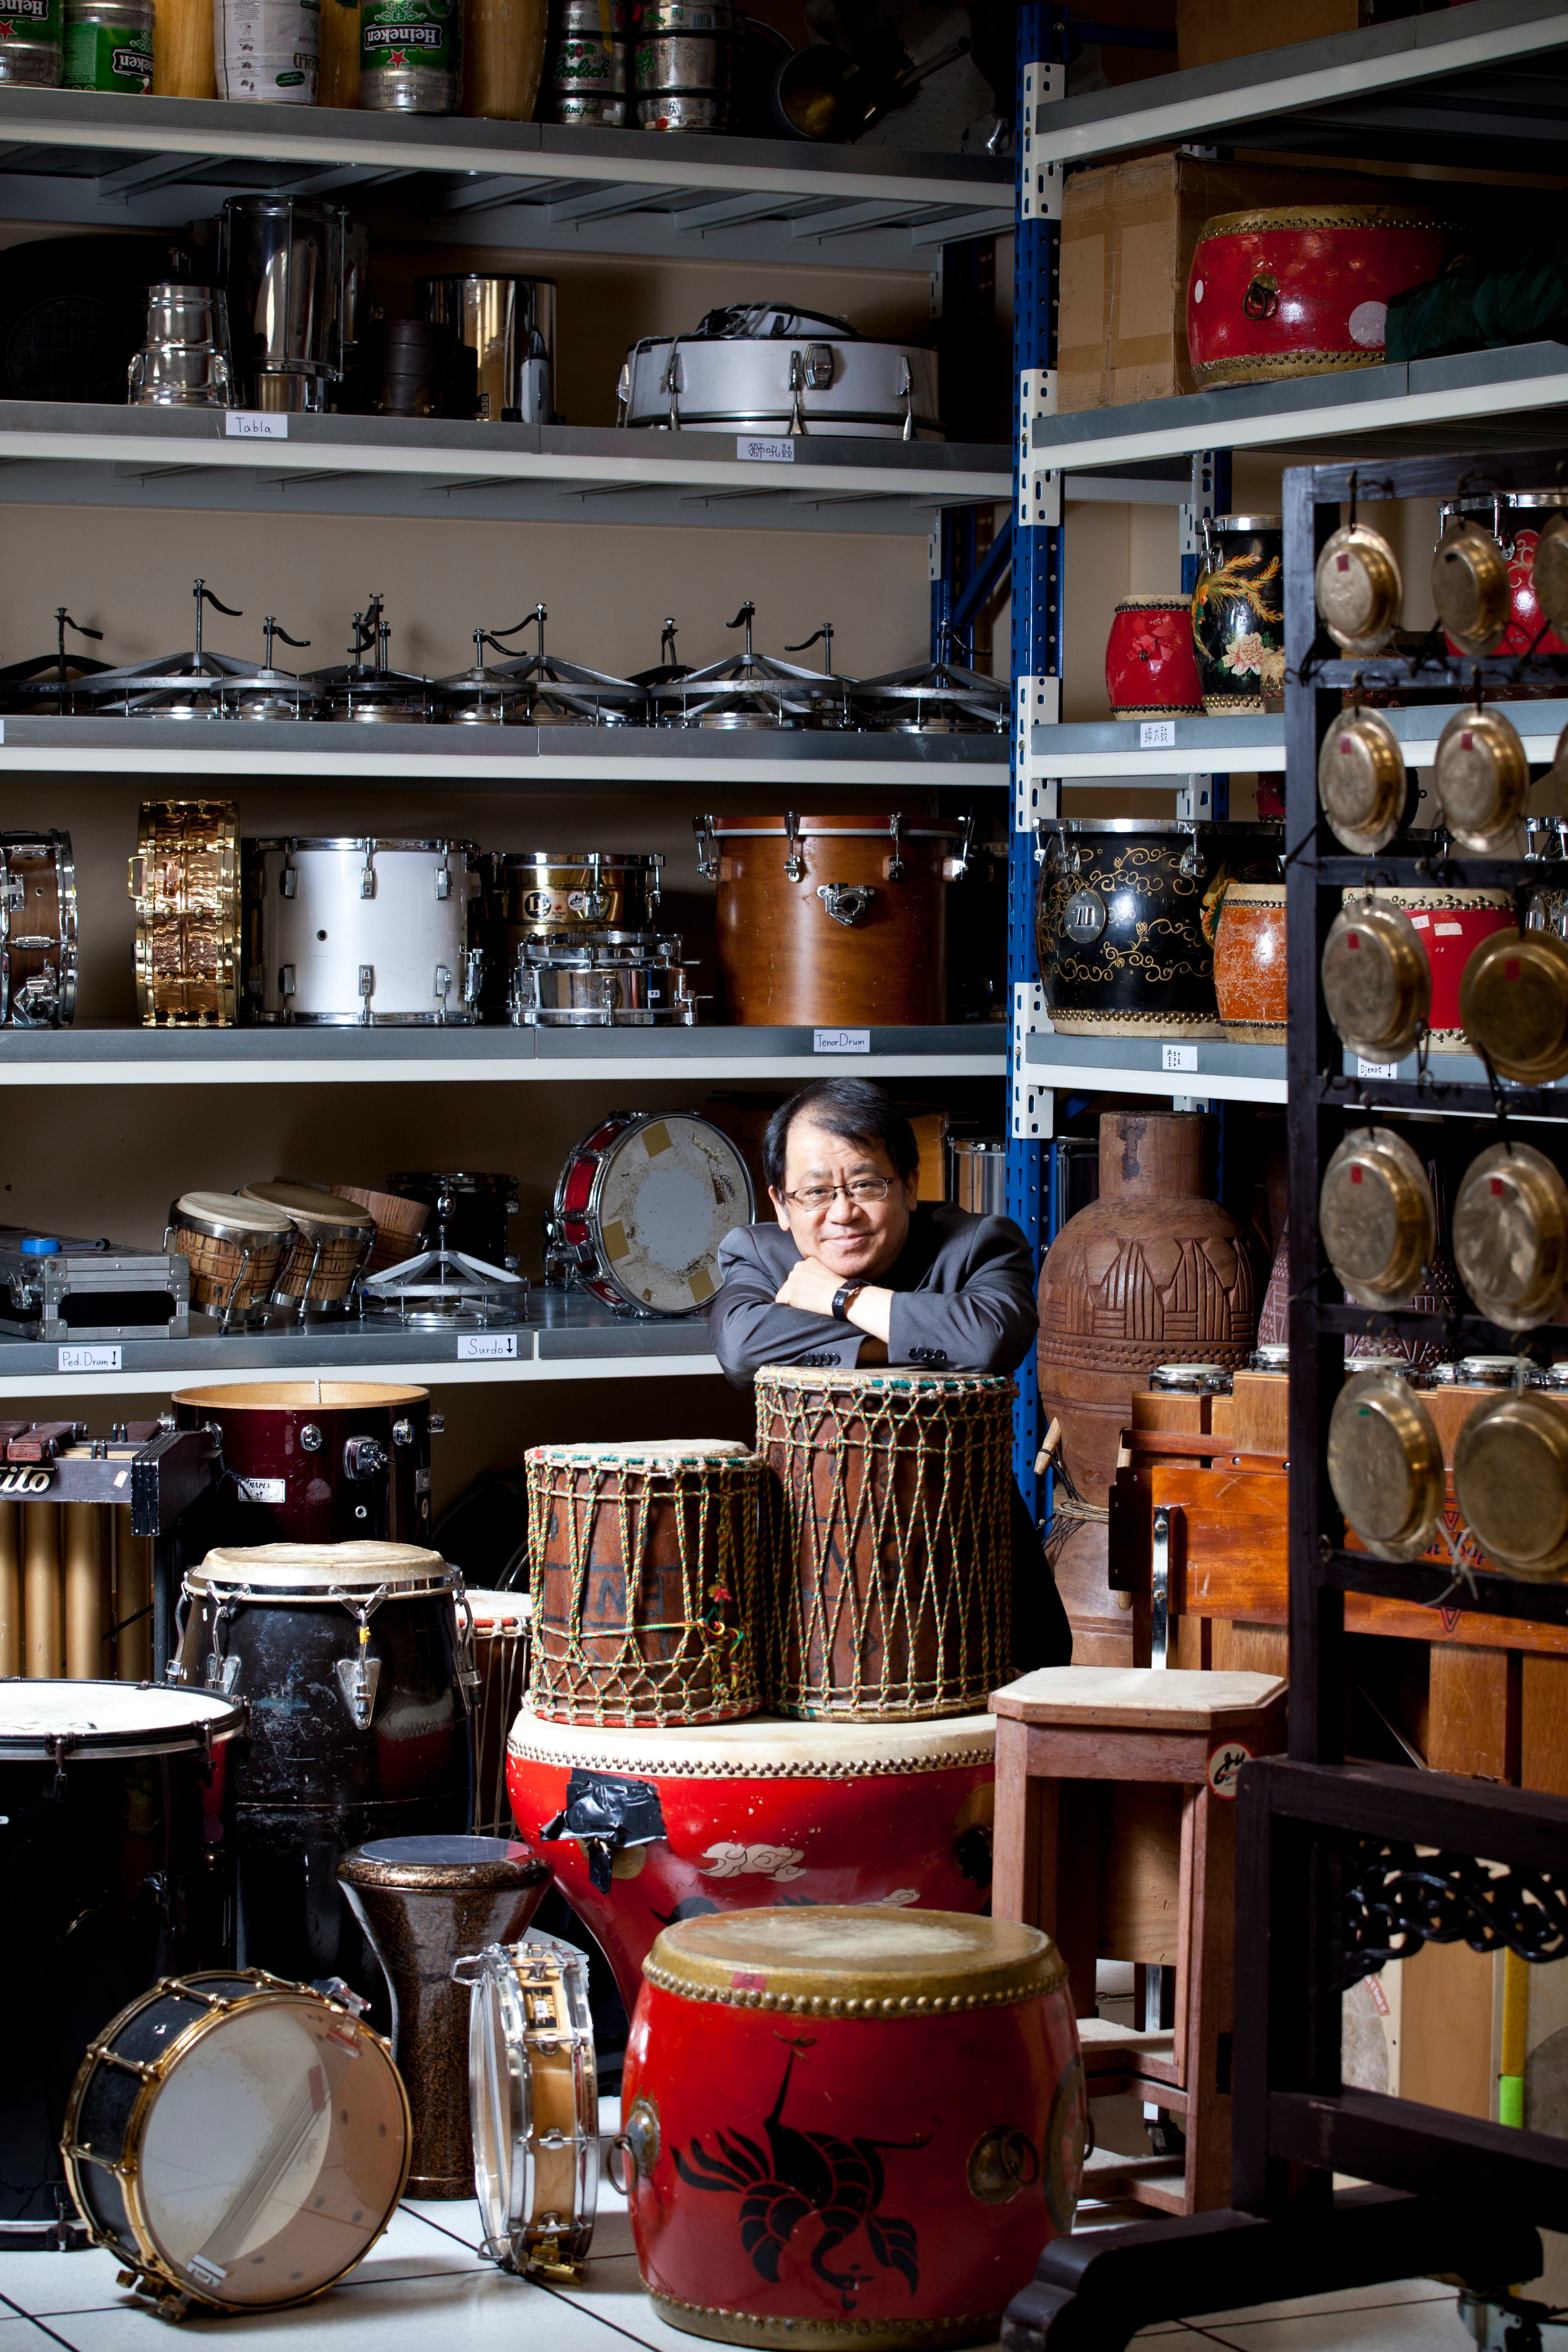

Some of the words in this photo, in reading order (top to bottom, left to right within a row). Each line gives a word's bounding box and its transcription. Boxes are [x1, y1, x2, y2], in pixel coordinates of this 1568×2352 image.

[367, 28, 437, 43] Heineken
[234, 416, 272, 434] Tabla
[747, 442, 793, 459] 獅吼鼓
[1360, 1064, 1382, 1076] Djembe
[468, 1338, 503, 1355] Surdo
[0, 1466, 58, 1493] ito
